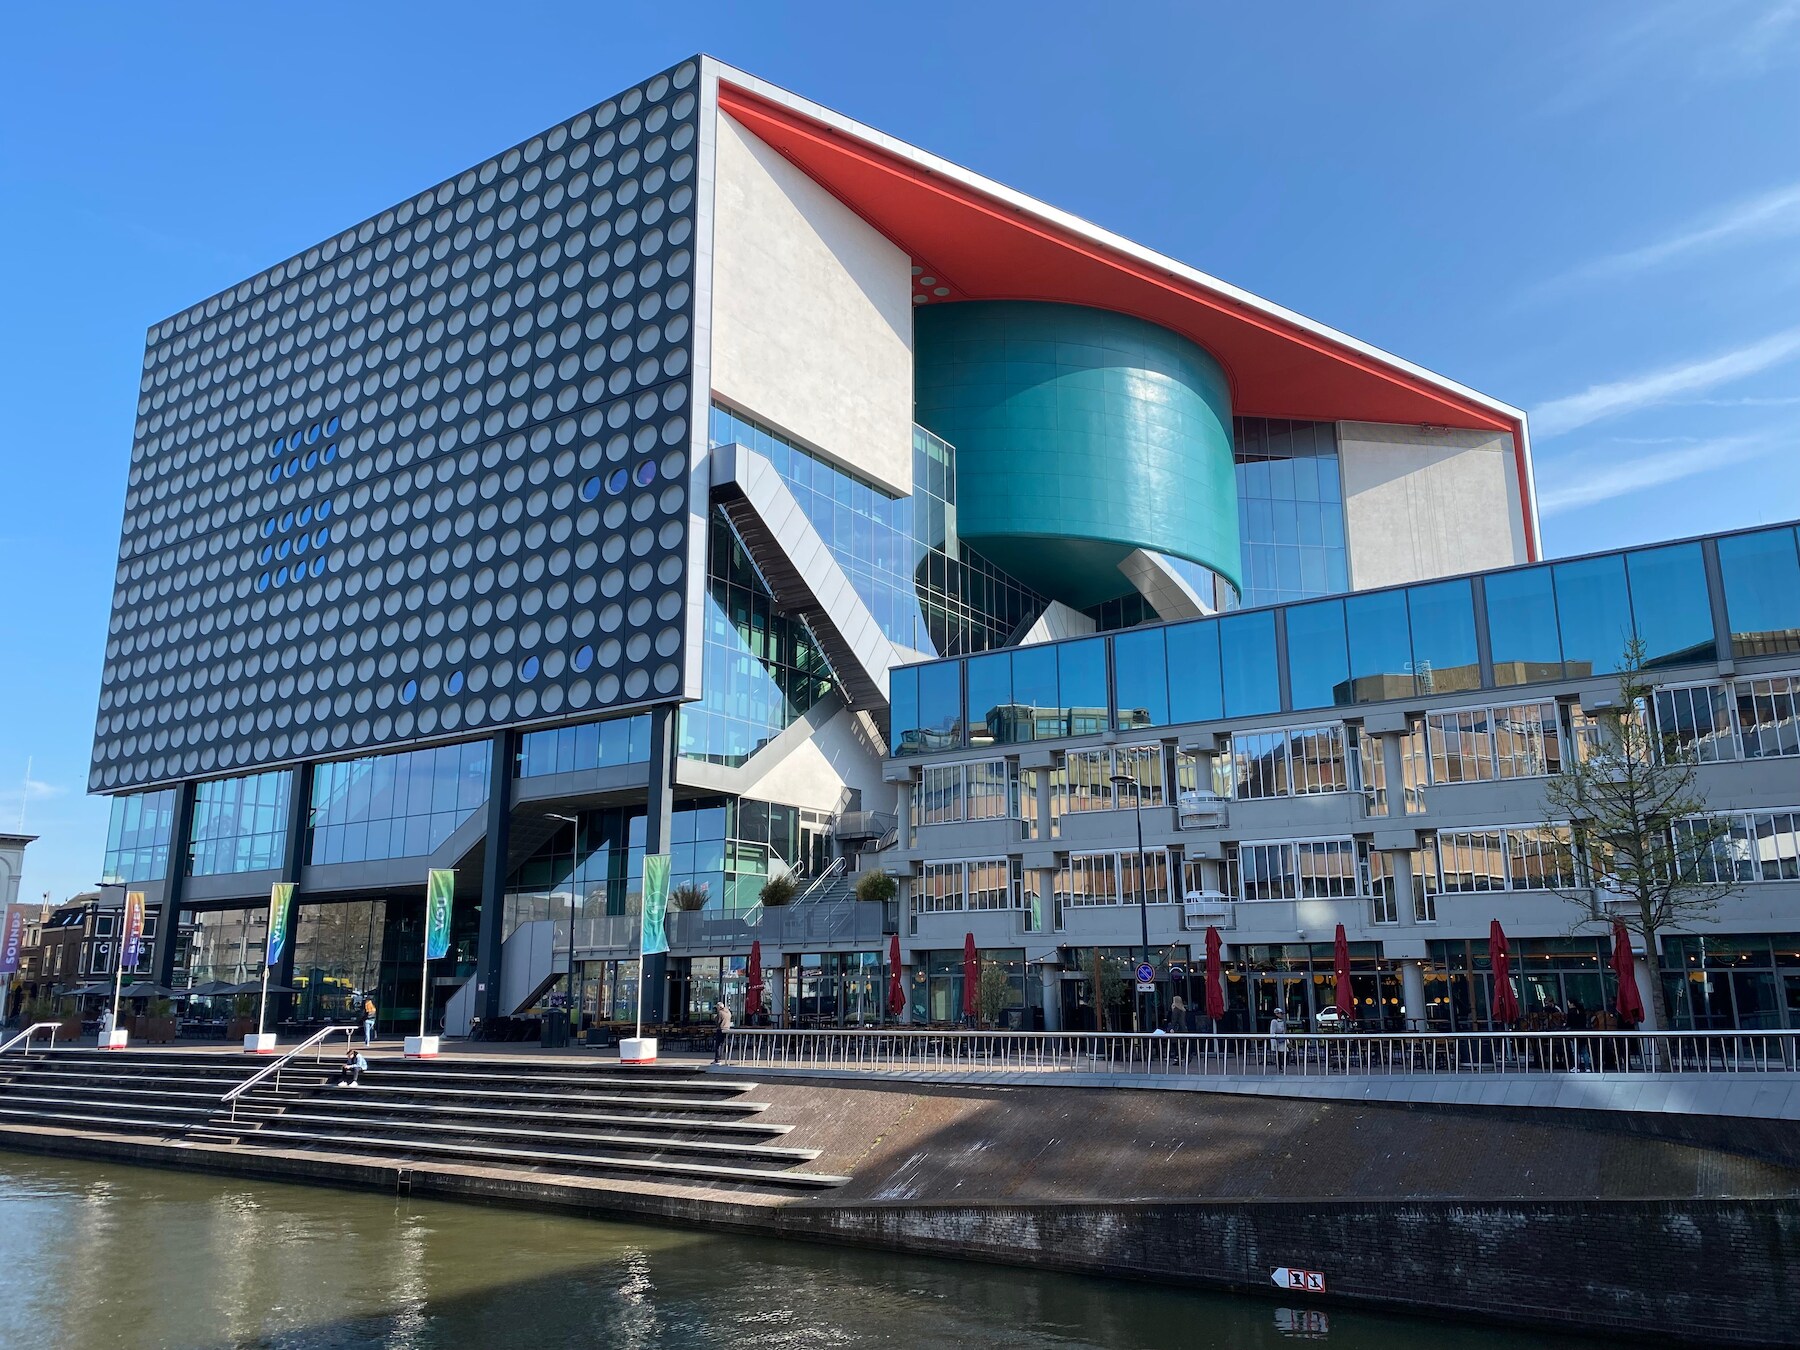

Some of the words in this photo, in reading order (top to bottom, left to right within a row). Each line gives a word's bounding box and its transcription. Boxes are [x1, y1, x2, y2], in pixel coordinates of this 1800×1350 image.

[128, 904, 141, 953] BETTER
[272, 905, 284, 943] WITH
[435, 896, 447, 931] YOU
[6, 911, 20, 964] SOUNDS
